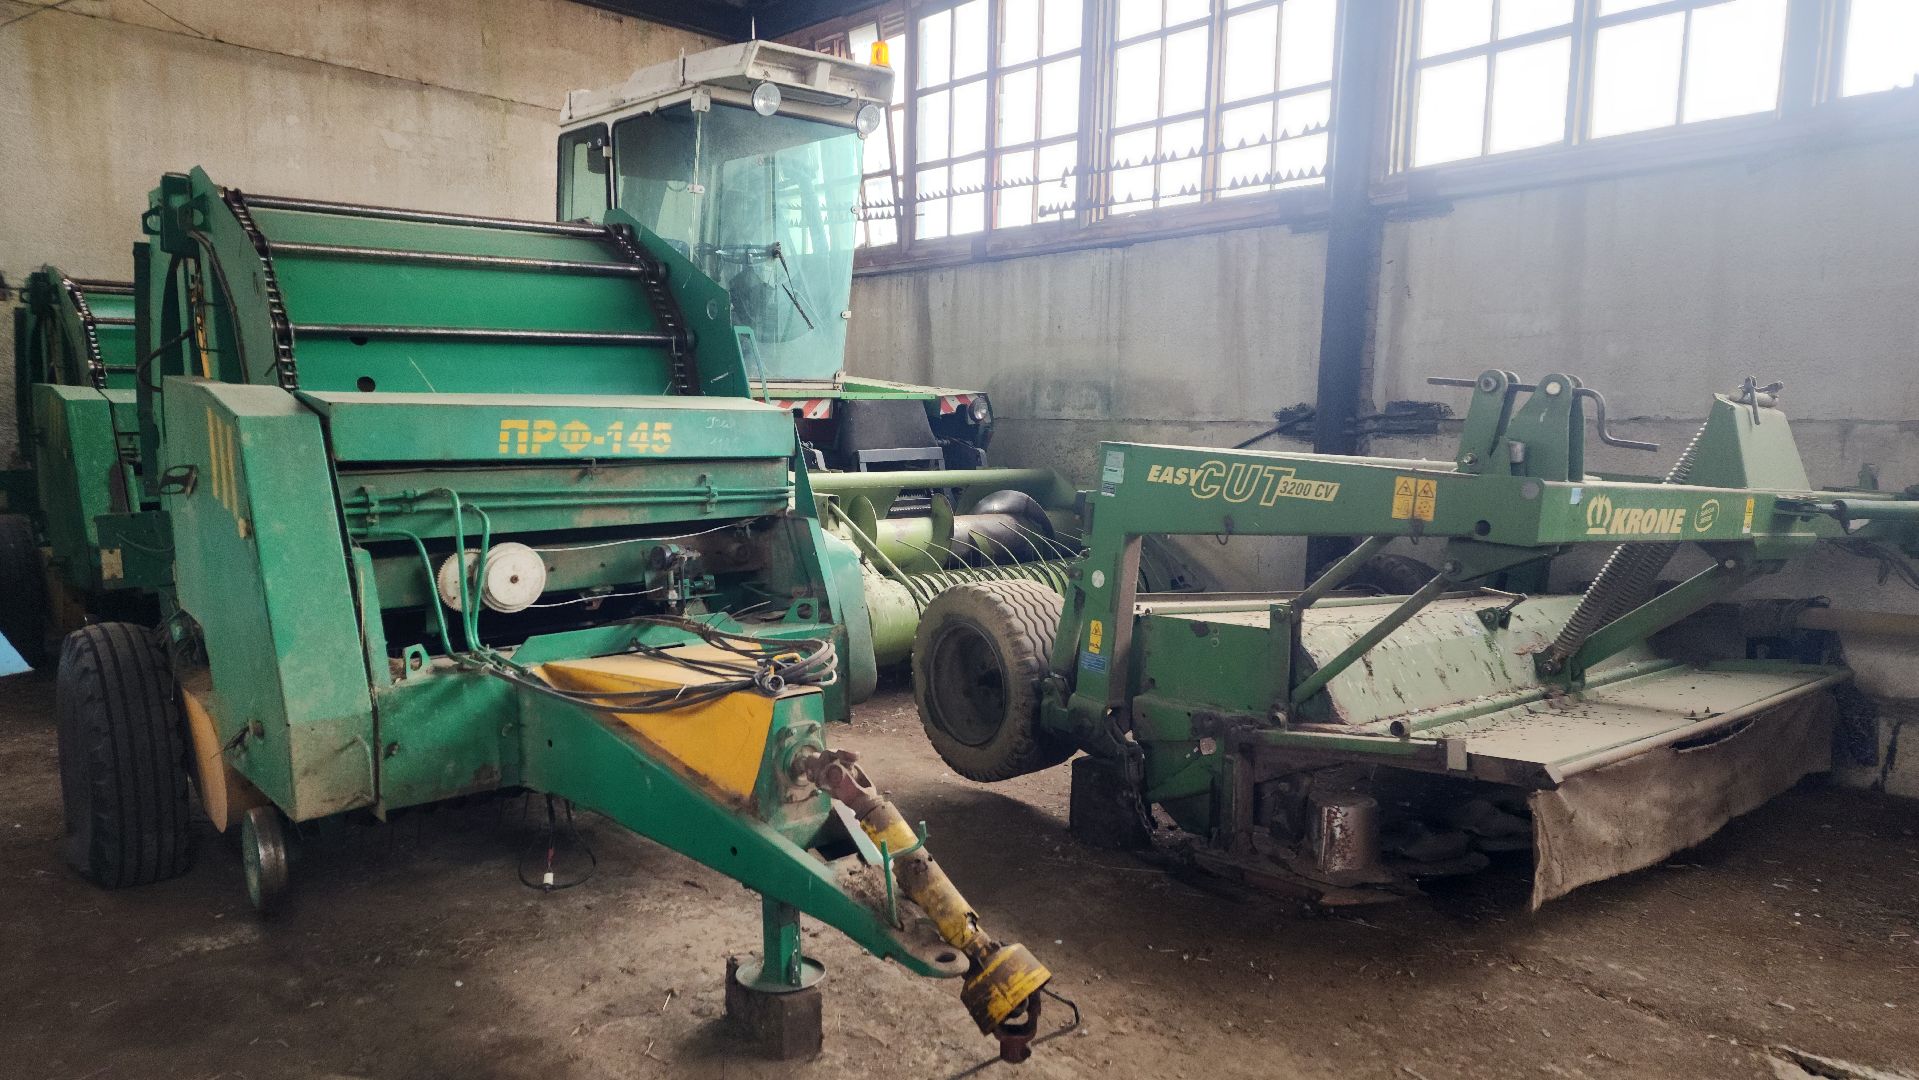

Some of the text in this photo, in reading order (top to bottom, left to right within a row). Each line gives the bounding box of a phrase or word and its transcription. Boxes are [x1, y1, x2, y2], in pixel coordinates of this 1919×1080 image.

[499, 419, 672, 454] ПРФ-145
[1147, 460, 1335, 506] EASY CUT 3200 CV
[1609, 507, 1686, 534] KRONE
